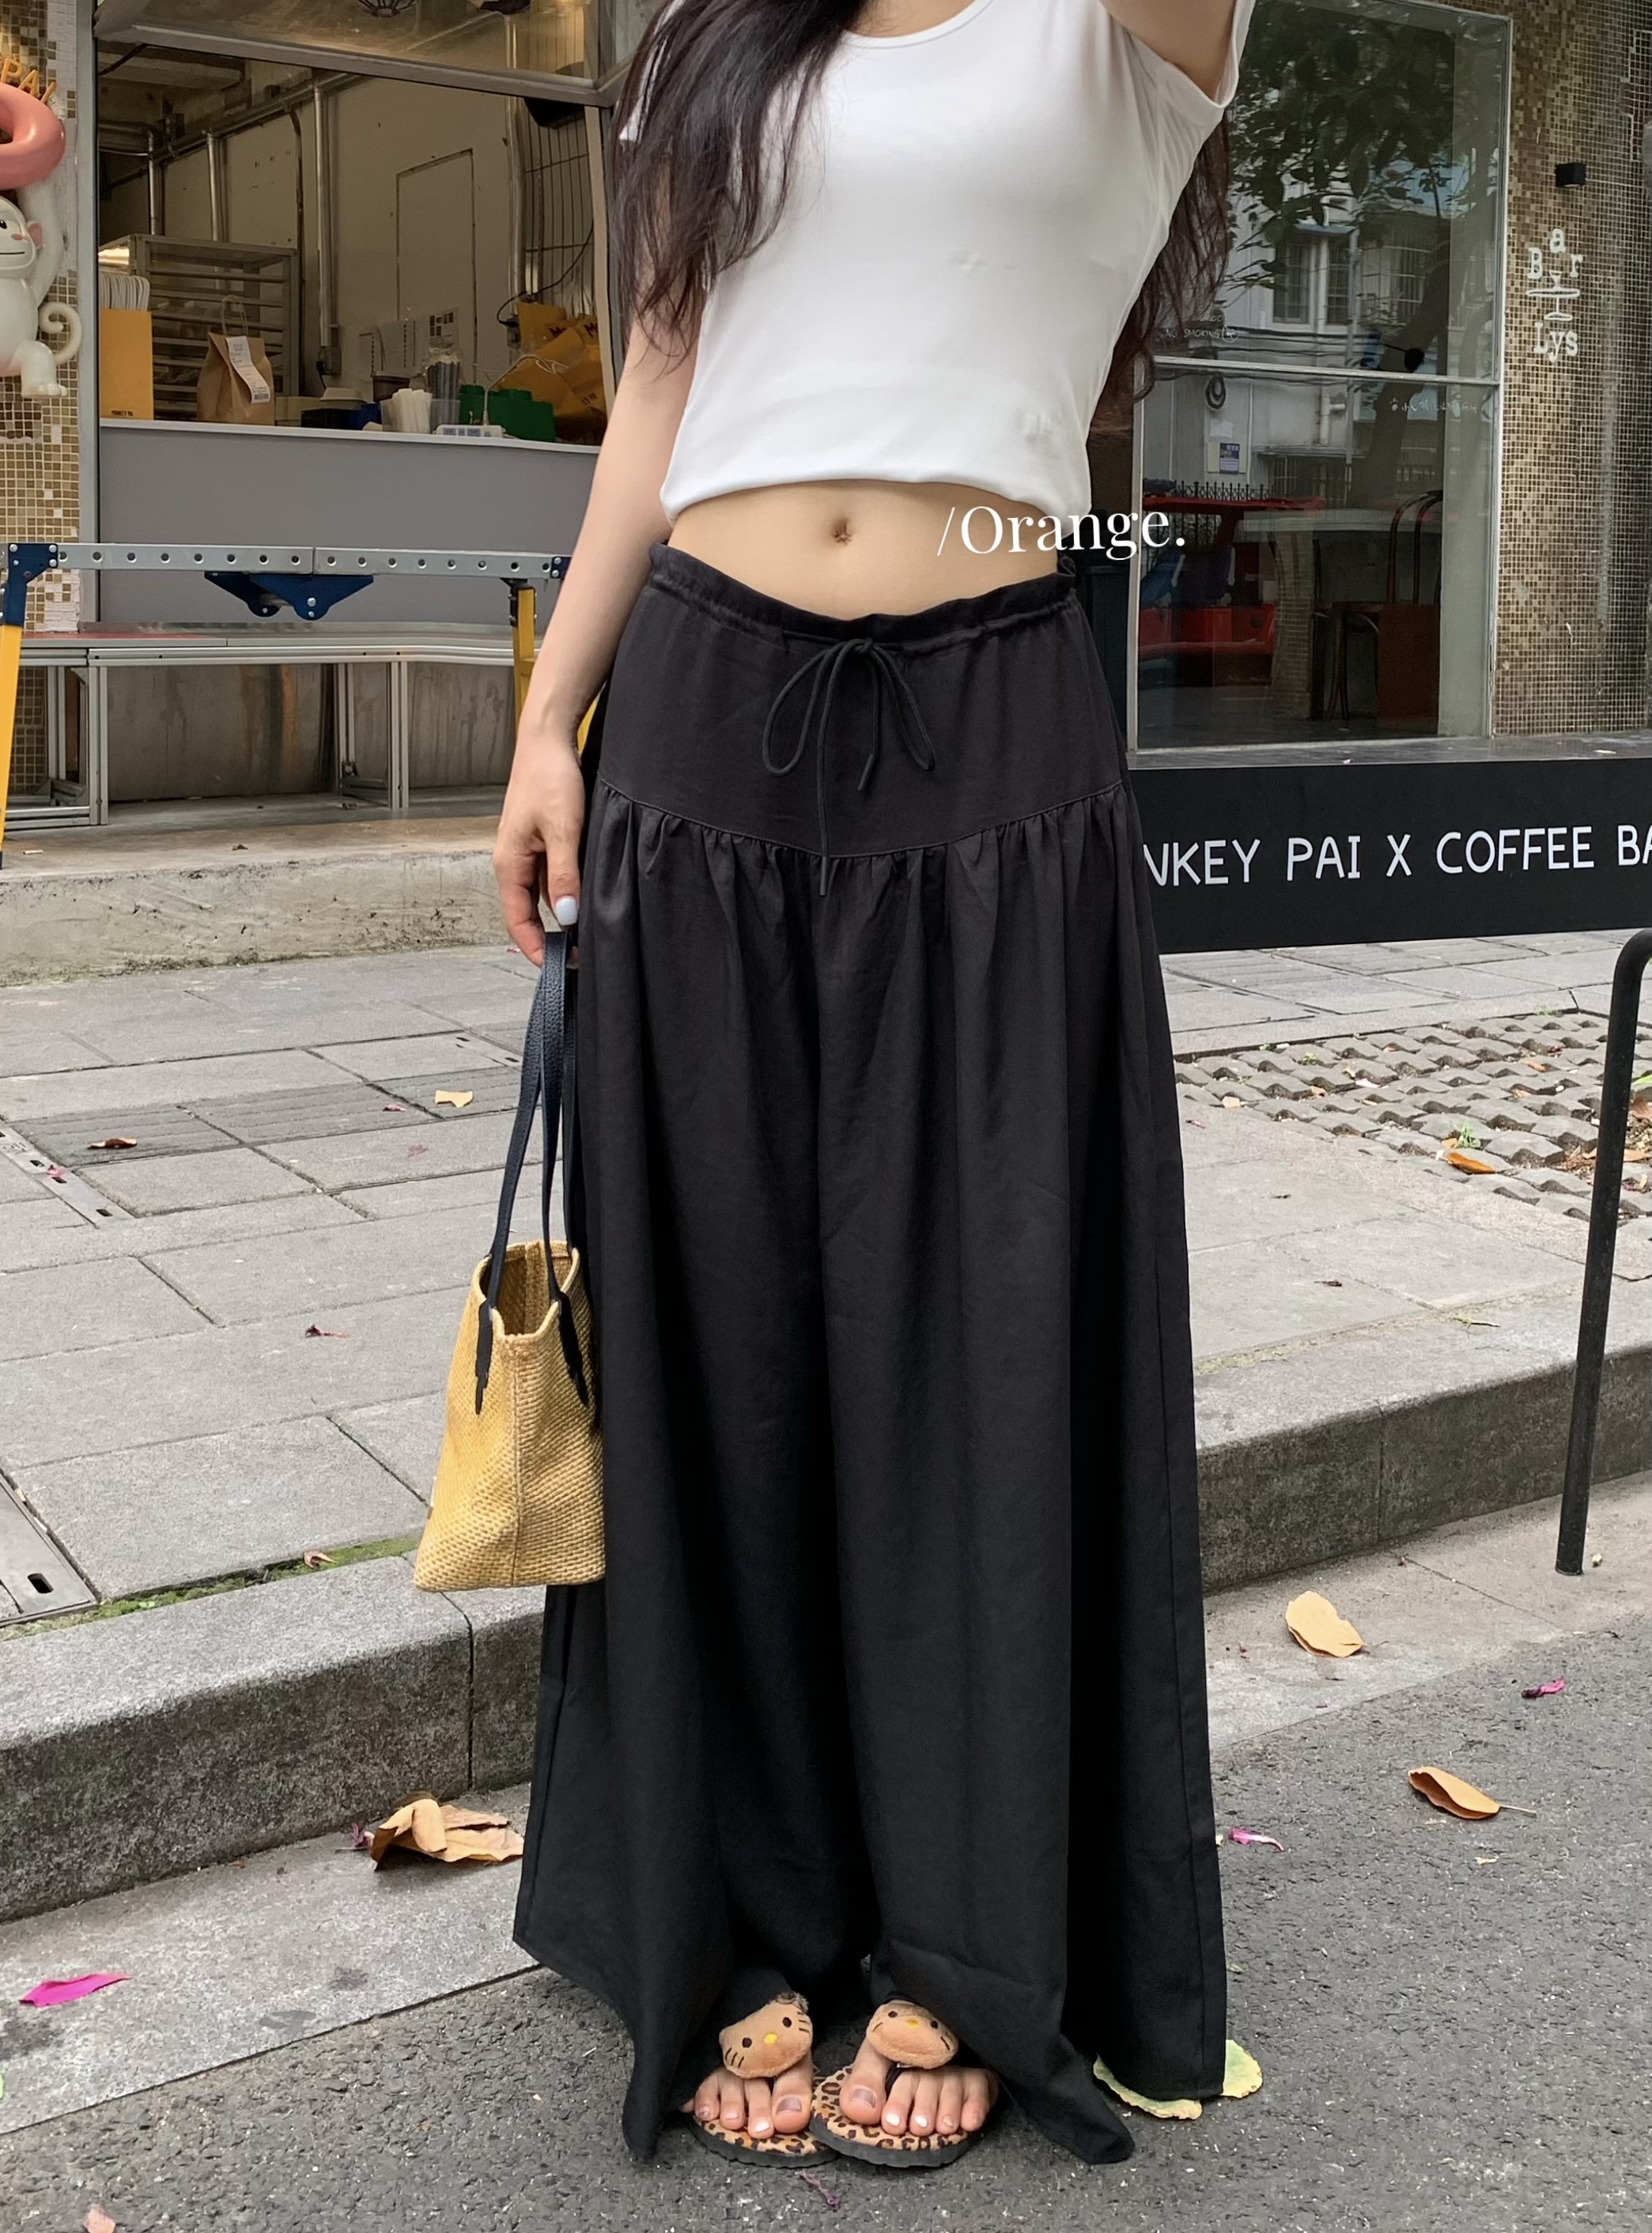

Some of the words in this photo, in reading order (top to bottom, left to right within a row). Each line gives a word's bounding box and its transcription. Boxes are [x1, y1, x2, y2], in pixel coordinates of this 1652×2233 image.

[1533, 322, 1578, 363] Lys
[1287, 835, 1362, 881] PAI
[1385, 833, 1412, 878] X
[1435, 826, 1594, 874] COFFEE
